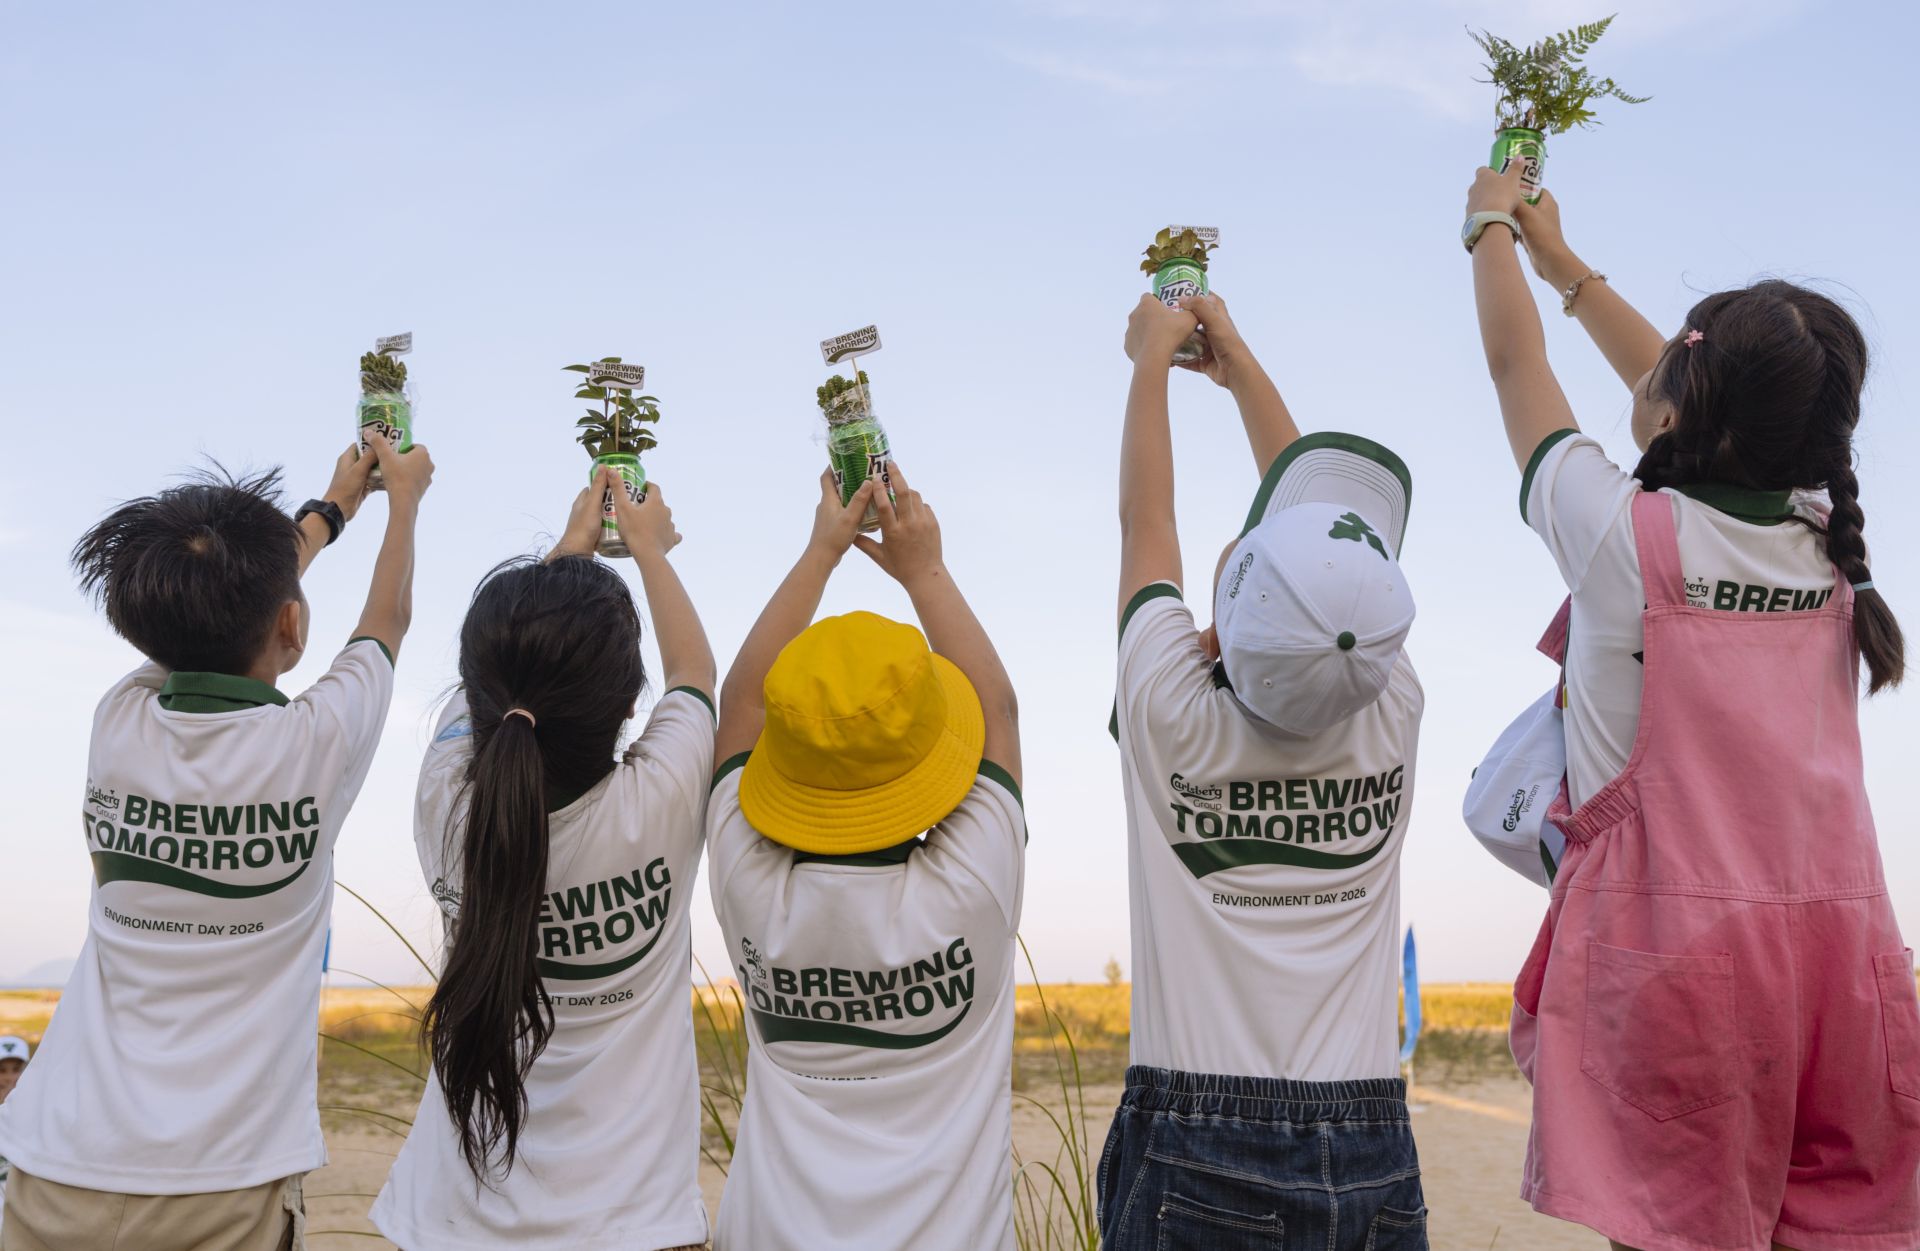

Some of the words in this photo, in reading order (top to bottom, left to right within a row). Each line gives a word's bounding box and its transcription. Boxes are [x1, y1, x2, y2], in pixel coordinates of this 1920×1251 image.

[824, 333, 877, 355] TOMORROW
[835, 325, 877, 345] BREWING
[592, 369, 644, 380] TOMORROW
[605, 363, 645, 374] BREWING
[1713, 580, 1834, 612] BREW
[1171, 772, 1222, 799] Carlsberg
[1229, 764, 1404, 811] BREWING
[1521, 784, 1541, 813] Vietnam
[123, 794, 320, 836] BREWING
[1170, 794, 1402, 844] TOMORROW
[1193, 799, 1222, 811] Group
[1503, 788, 1526, 832] Carlsberg
[83, 812, 320, 870] TOMORROW
[1212, 893, 1311, 907] ENVIRONMENT
[1314, 893, 1338, 905] DAY
[1341, 887, 1366, 902] 2026
[104, 906, 193, 934] ENVIRONMENT
[198, 924, 225, 935] DAY
[229, 922, 264, 935] 2026
[771, 937, 973, 998] BREWING
[568, 996, 596, 1006] DAY
[600, 989, 634, 1005] 2026
[739, 964, 975, 1022] TOMORROW
